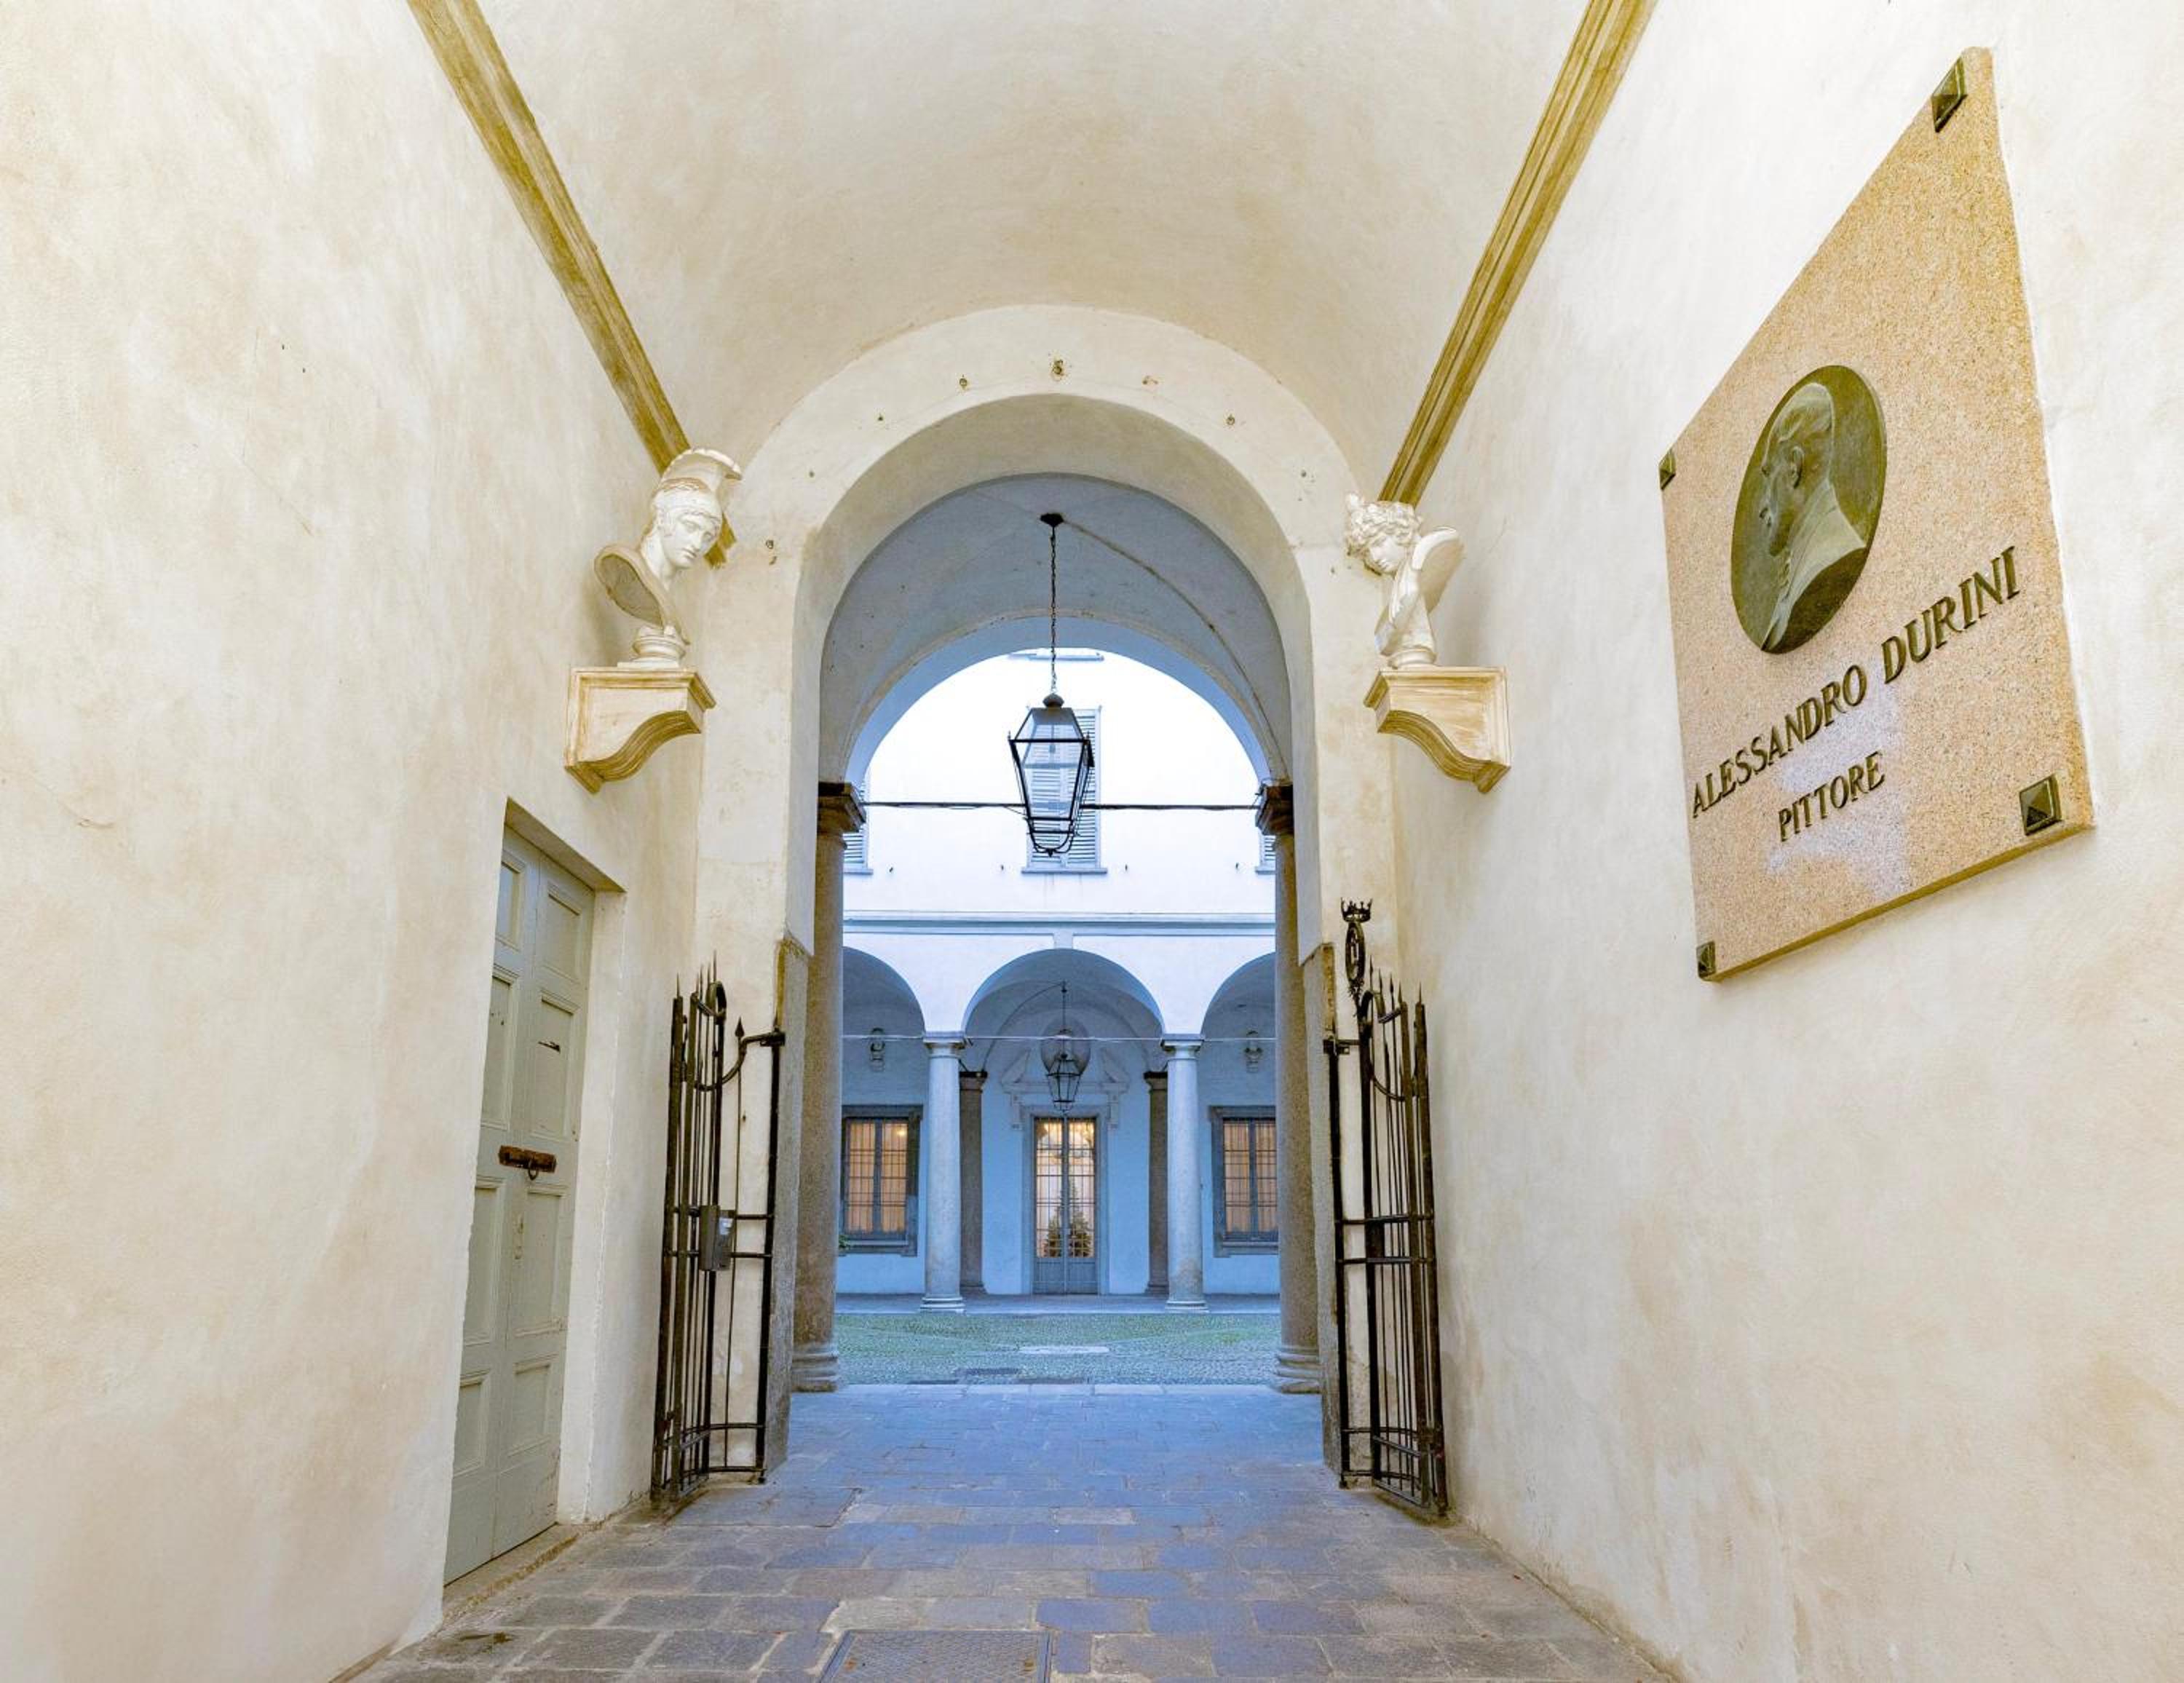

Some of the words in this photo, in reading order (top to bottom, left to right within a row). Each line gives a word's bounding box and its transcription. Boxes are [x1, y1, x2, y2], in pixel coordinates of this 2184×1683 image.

[1691, 665, 1867, 818] ALESSANDRO
[1881, 546, 2020, 684] DURINI
[1778, 751, 1886, 842] PITTORE
